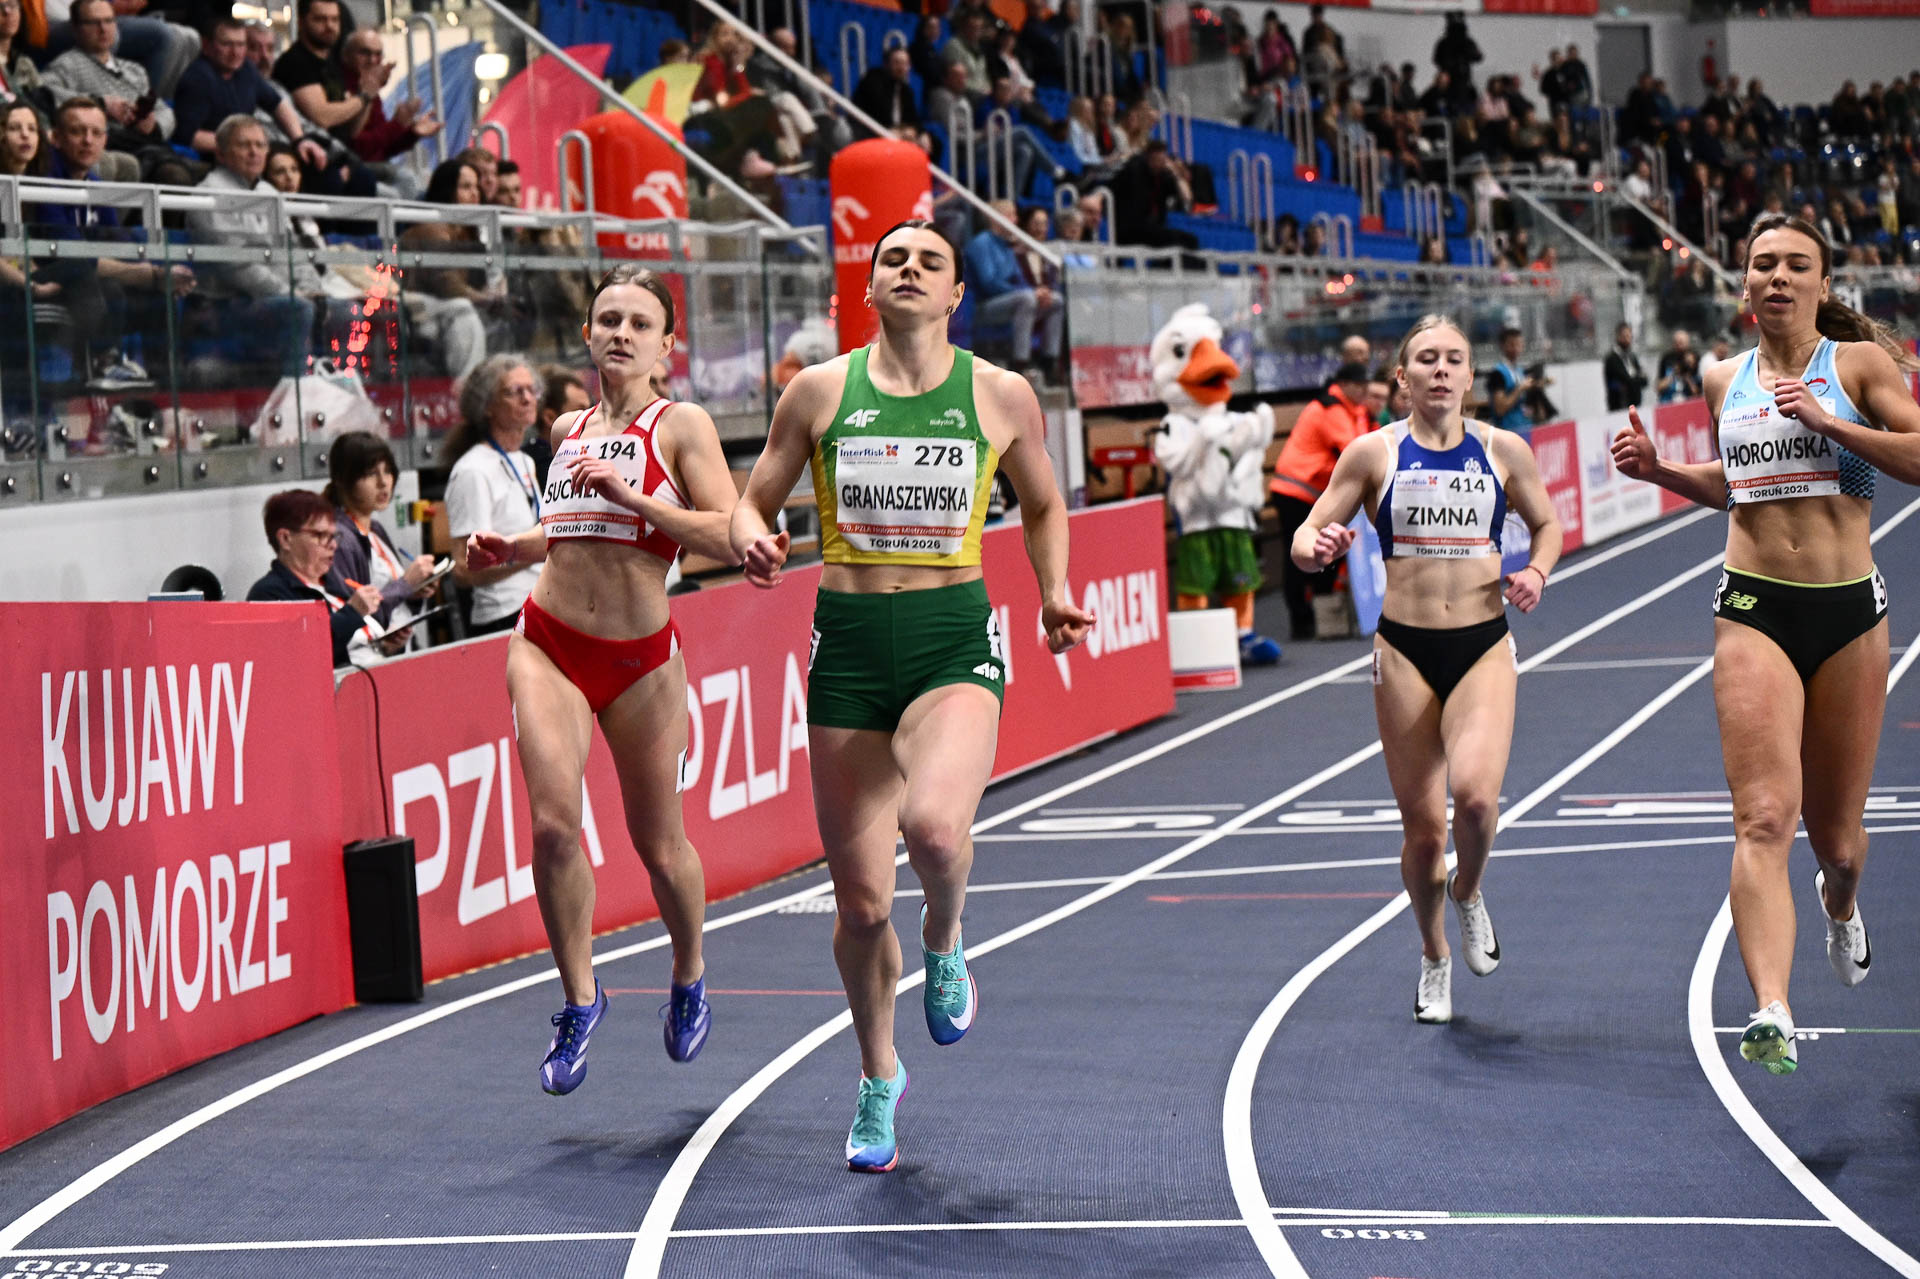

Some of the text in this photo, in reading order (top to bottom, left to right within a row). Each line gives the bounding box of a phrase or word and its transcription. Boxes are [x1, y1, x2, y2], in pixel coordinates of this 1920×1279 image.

[844, 409, 880, 428] 4F
[598, 441, 636, 460] 194
[840, 447, 884, 458] InterRisk
[914, 445, 963, 467] 278
[1727, 434, 1832, 468] HOROWSKA
[1449, 477, 1485, 493] 414
[1749, 485, 1782, 498] TORUŃ
[1784, 484, 1809, 497] 2026
[842, 485, 968, 512] GRANASZEWSKA
[1407, 507, 1478, 526] ZIMNA
[551, 522, 606, 533] TORUŃ 2026
[870, 537, 941, 549] TORUŃ 2026
[1084, 569, 1160, 660] ORLEN
[42, 660, 254, 839] KUJAWY
[47, 839, 292, 1061] POMORZE
